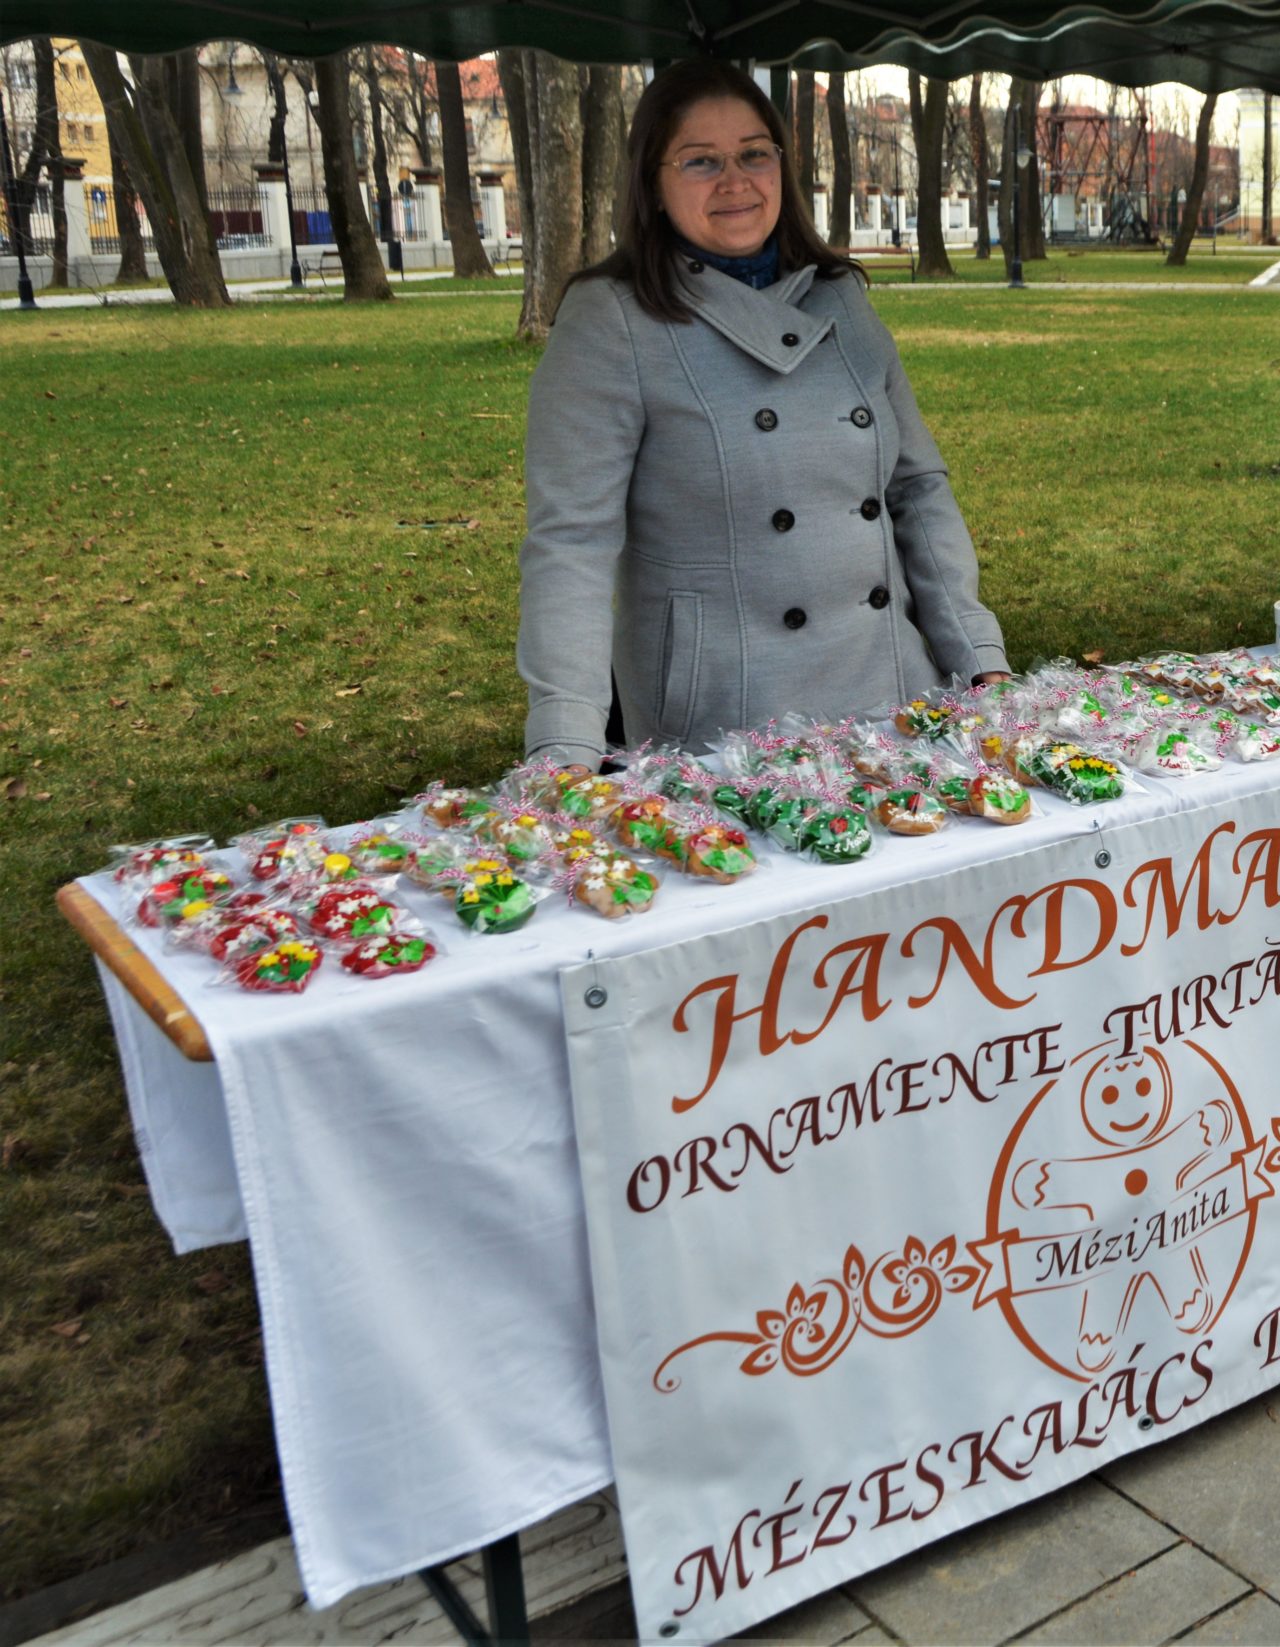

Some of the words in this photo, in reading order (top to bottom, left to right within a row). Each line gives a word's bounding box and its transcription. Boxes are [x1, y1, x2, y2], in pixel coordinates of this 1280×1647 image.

[626, 1022, 1066, 1213] ORNAMENTE
[1035, 1187, 1230, 1282] MéziAnita
[673, 1339, 1214, 1617] MÉZESKALÁCS
